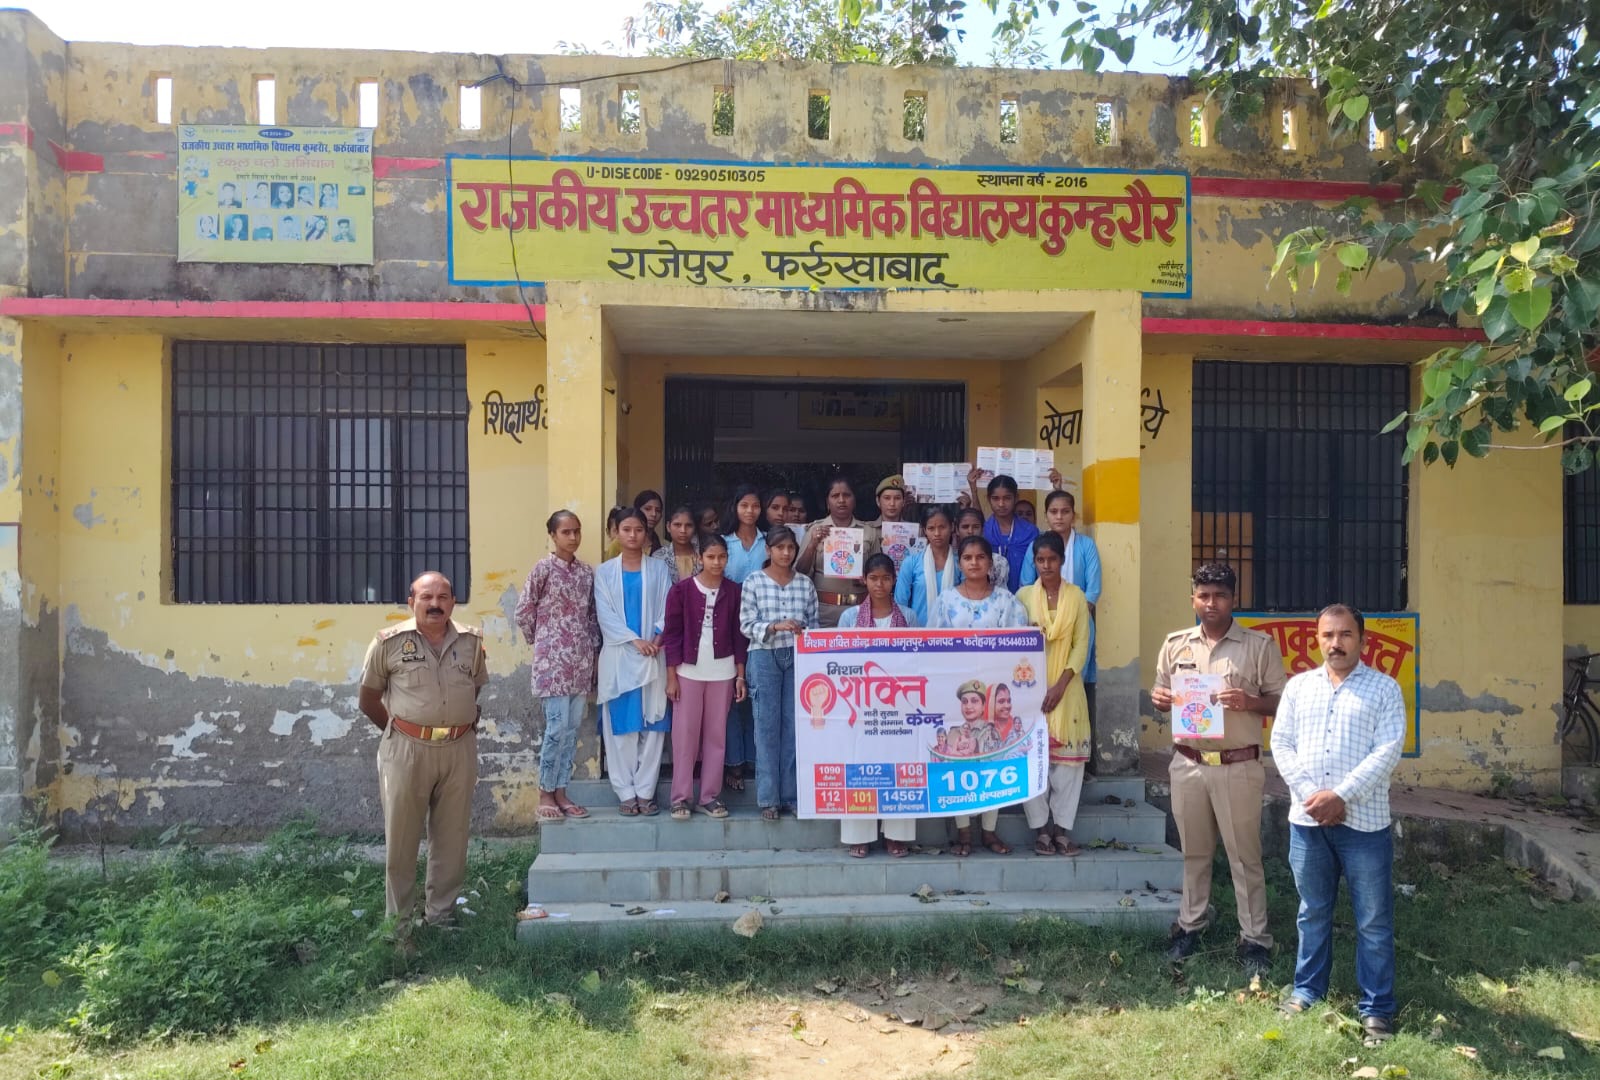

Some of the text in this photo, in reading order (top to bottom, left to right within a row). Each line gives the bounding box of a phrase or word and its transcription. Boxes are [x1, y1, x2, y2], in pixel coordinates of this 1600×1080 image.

[181, 140, 210, 151] राजकीय
[236, 140, 269, 151] माध्यमिक
[271, 141, 301, 152] विद्यालय
[217, 155, 335, 172] स्कूल चलो अभियान
[586, 166, 632, 180] U-DISE
[632, 167, 662, 180] CODE
[675, 168, 766, 183] 09290510305
[976, 174, 1024, 188] स्थापना
[1026, 171, 1045, 188] वर्ष
[1055, 175, 1088, 188] 2016
[456, 168, 1184, 257] राजकीय उच्चतर माध्यमिक विद्यालय कुम्हरौर
[481, 384, 544, 444] शिक्षार्थ
[803, 634, 826, 648] मिशन
[828, 634, 850, 648] शक्ति
[927, 636, 954, 648] जनपद
[998, 636, 1038, 648] 9454403320
[826, 661, 864, 676] मिशन
[837, 660, 929, 728] शक्ति
[864, 708, 879, 717] नारी
[905, 708, 946, 728] केन्द्र
[864, 718, 879, 727] नारी
[864, 727, 879, 736] नारी
[819, 766, 841, 774] 1090
[858, 765, 882, 775] 102
[900, 765, 924, 776] 108
[941, 765, 1019, 791] 1076
[821, 790, 841, 802] 112
[853, 791, 873, 803] 101
[883, 790, 924, 801] 14567
[937, 791, 978, 809] मुख्यमंत्री
